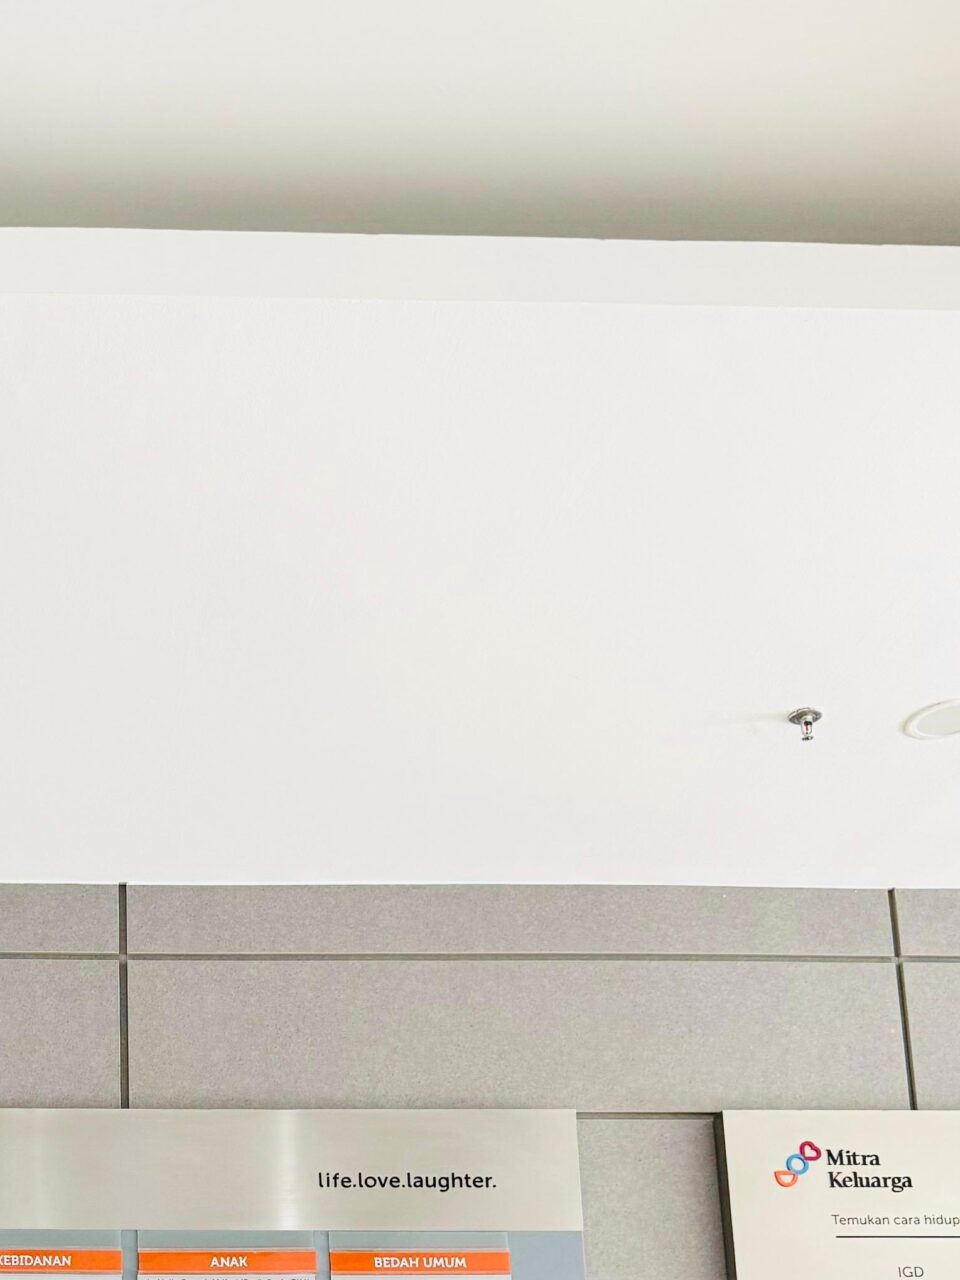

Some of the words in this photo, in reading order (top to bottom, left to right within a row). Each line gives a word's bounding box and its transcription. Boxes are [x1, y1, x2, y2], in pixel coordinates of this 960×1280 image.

[825, 1149, 881, 1166] Mitra
[318, 1171, 497, 1193] life.love.laughter.
[827, 1171, 913, 1193] Keluarga
[831, 1213, 891, 1226] Temukan
[893, 1216, 921, 1226] cara
[923, 1213, 960, 1228] hidup
[209, 1256, 248, 1269] ANAK
[373, 1257, 419, 1269] BEDAH
[422, 1257, 467, 1269] UMUM
[897, 1265, 925, 1279] IGD
